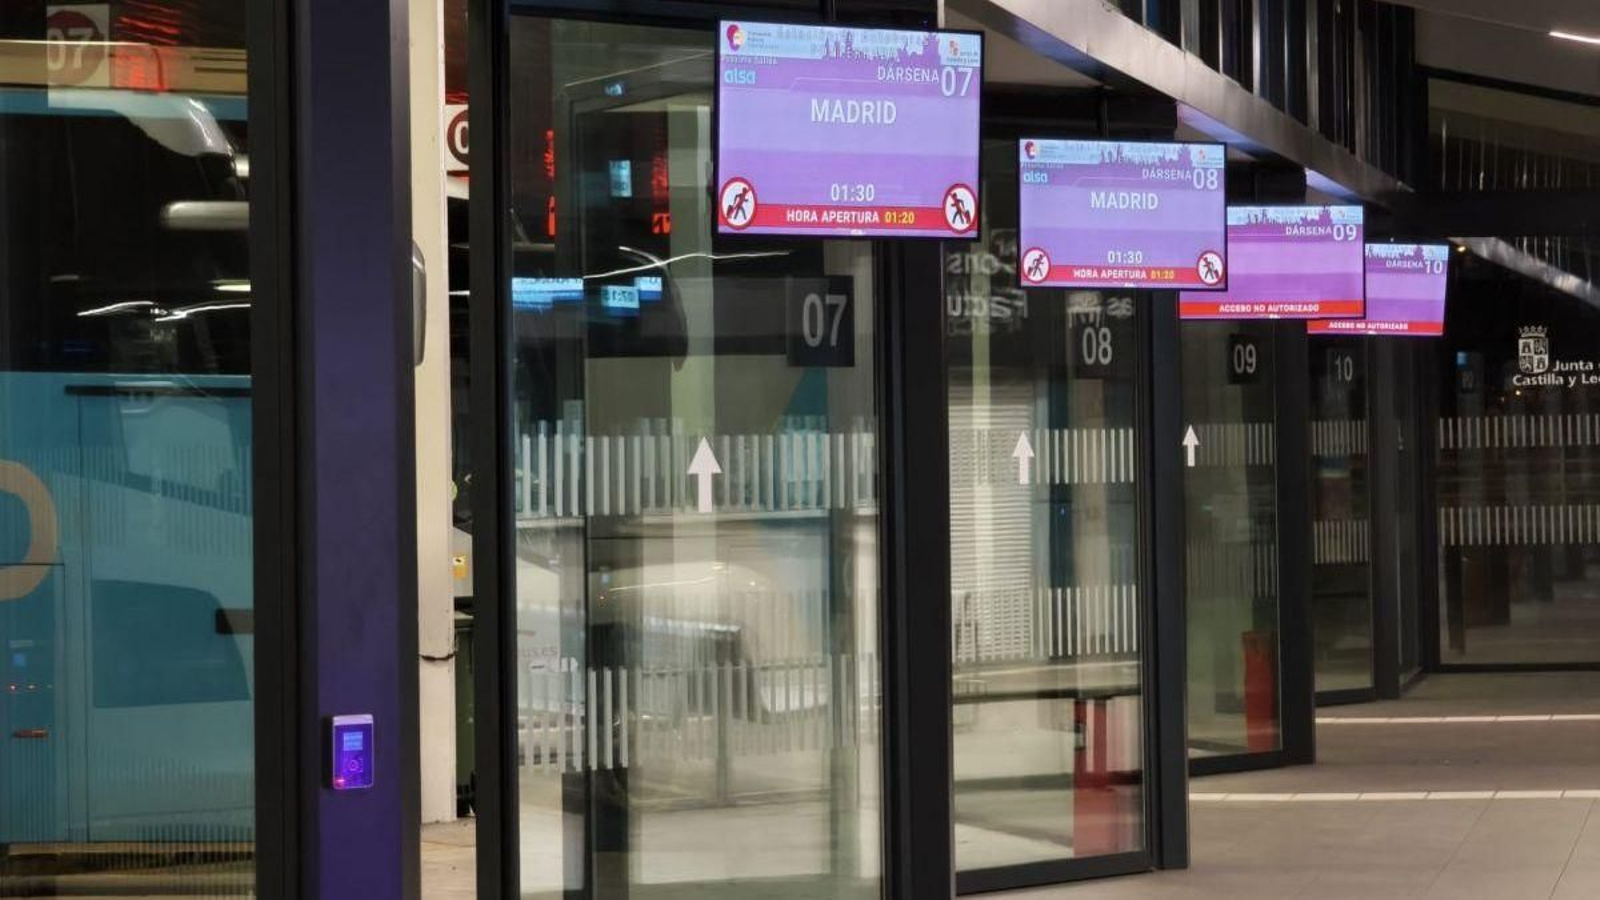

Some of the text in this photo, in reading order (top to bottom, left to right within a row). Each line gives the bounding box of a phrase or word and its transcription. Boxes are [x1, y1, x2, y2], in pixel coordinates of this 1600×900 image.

[47, 27, 93, 70] 07
[724, 69, 756, 85] alsa
[877, 64, 973, 97] DÁRSENA 07
[811, 98, 897, 124] MADRID
[1023, 171, 1048, 183] alsa
[1142, 167, 1218, 190] DÁRSENA 08
[830, 183, 875, 202] 01:30
[1090, 192, 1159, 210] MADRID
[786, 209, 916, 225] HORA APERTURA 01:20
[1285, 224, 1357, 241] DÁRSENA 09
[1107, 251, 1143, 264] 01:30
[1073, 268, 1175, 280] HORA APERTURA 01:20
[1425, 261, 1443, 274] 10
[1219, 303, 1320, 313] ACCESO NO AUTORIZADO
[803, 293, 847, 347] 07
[1356, 321, 1367, 330] NO
[1368, 321, 1409, 331] AUTORIZADO
[1082, 327, 1113, 365] 08
[1234, 344, 1257, 374] 09
[1552, 360, 1594, 372] Junta
[1335, 355, 1353, 381] 10
[1512, 373, 1564, 386] Castilla
[1568, 375, 1577, 388] y
